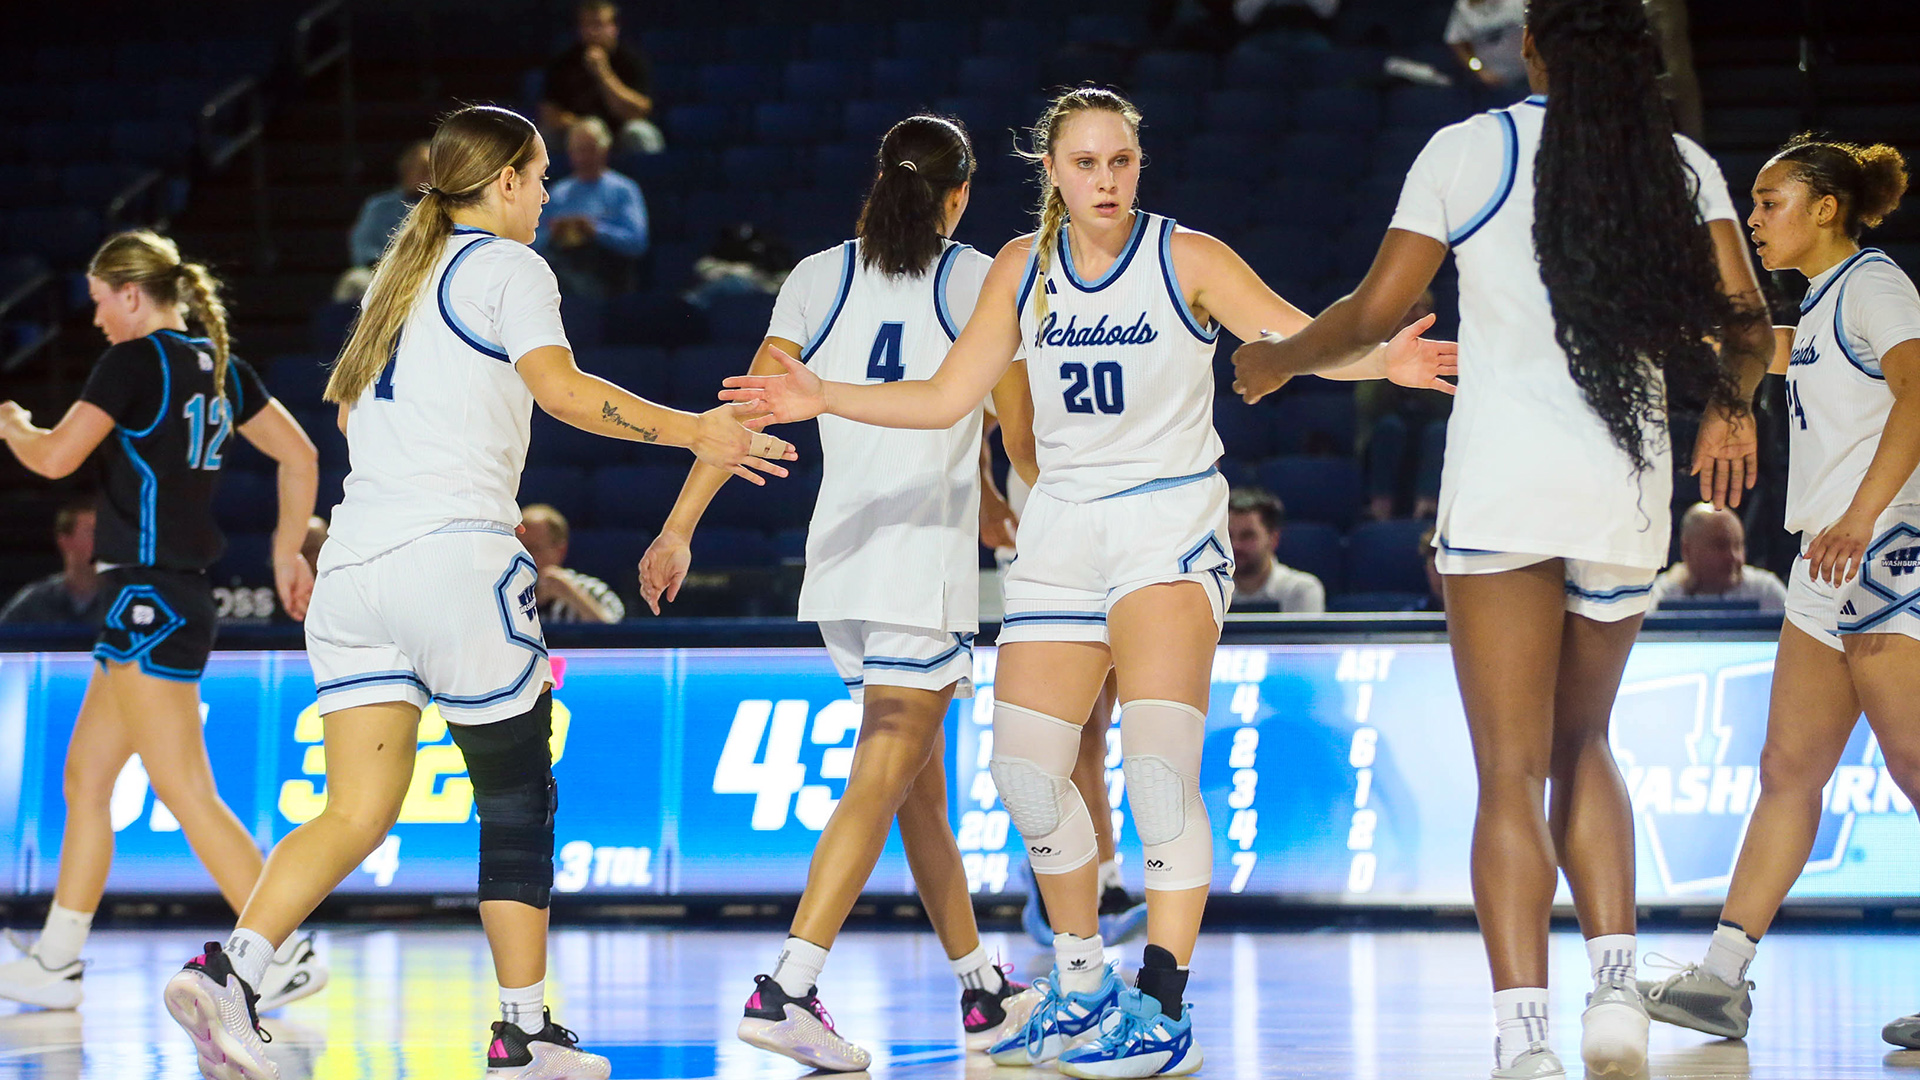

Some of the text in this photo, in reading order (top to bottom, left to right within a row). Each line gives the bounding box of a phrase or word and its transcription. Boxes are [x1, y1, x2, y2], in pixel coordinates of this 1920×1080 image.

[866, 321, 906, 382] 4
[1059, 360, 1124, 416] 20
[183, 393, 233, 471] 12
[1336, 650, 1395, 682] AST
[1230, 683, 1259, 723] 4
[1355, 683, 1372, 723] 1
[712, 699, 864, 831] 43
[1229, 727, 1259, 768] 2
[1350, 727, 1378, 768] 6
[970, 768, 1372, 810] 4 3 1
[960, 809, 1377, 850] 20 4 2
[555, 841, 651, 893] 3 TOL
[1230, 852, 1257, 893] 7
[1349, 852, 1376, 893] 0
